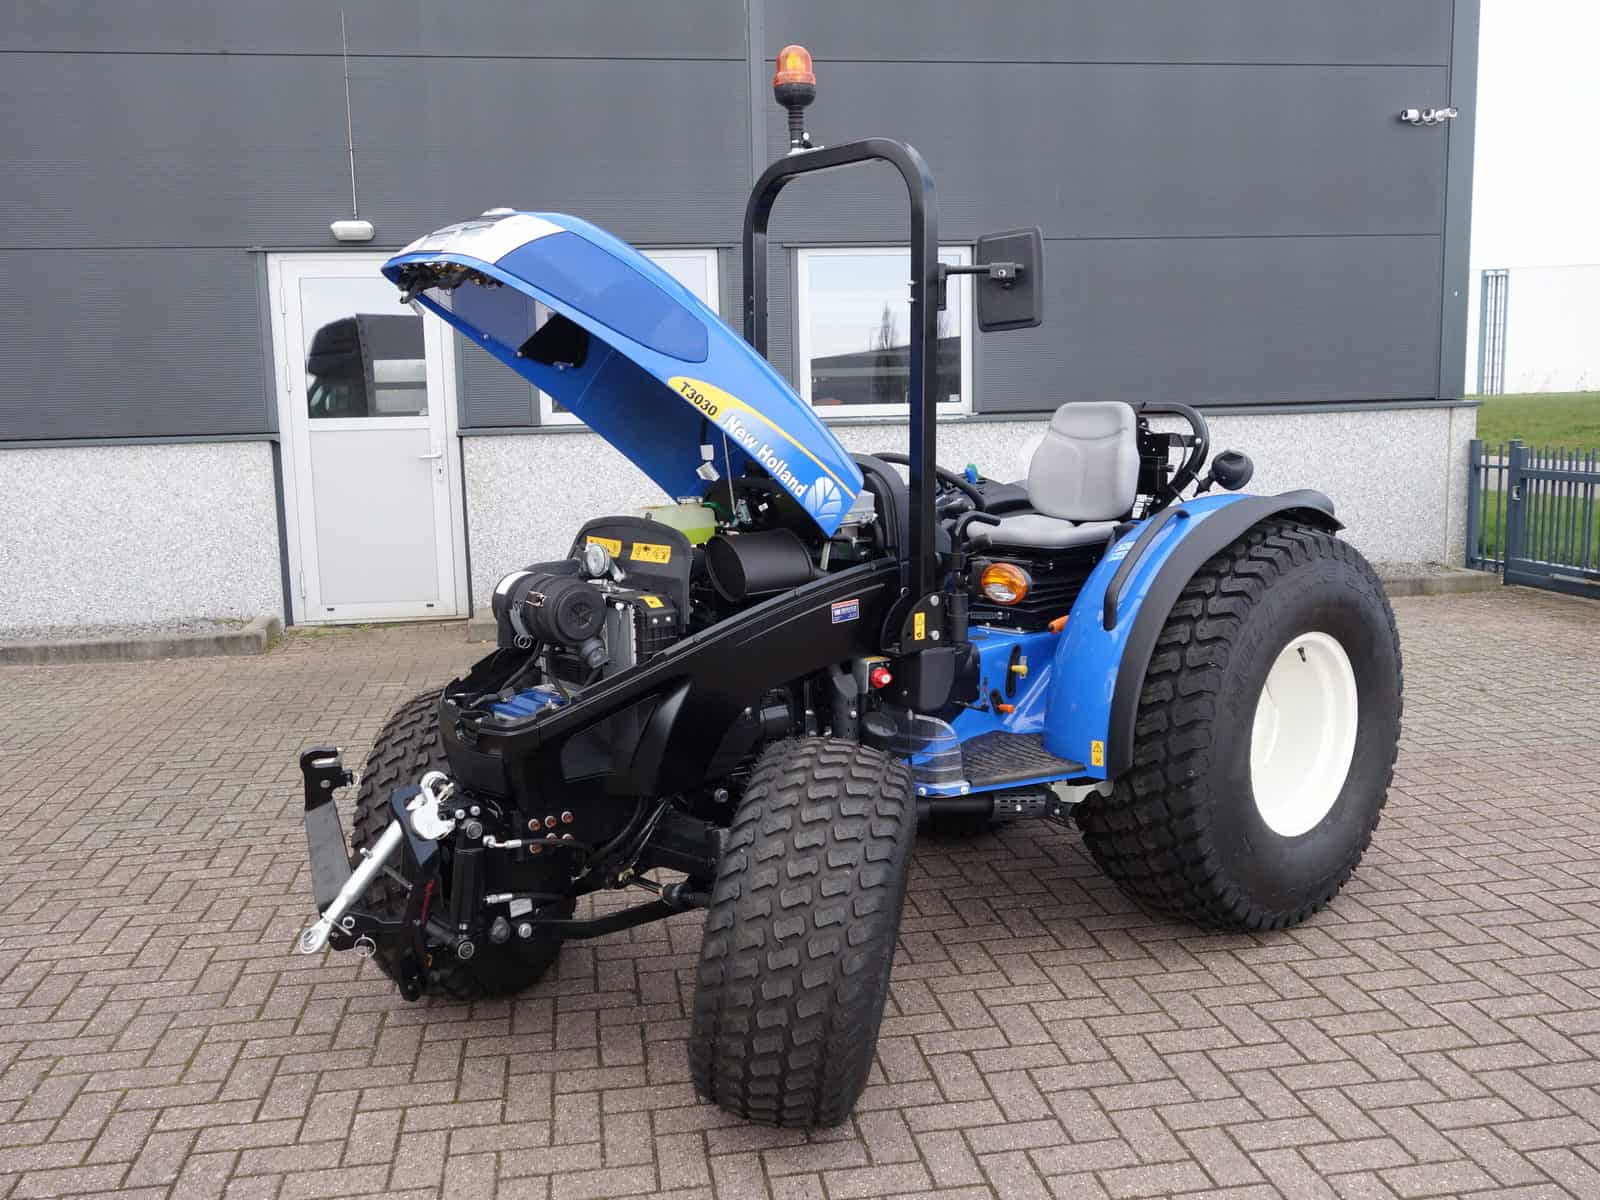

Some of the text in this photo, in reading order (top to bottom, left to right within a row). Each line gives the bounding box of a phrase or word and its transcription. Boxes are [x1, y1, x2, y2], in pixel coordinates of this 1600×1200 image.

[680, 381, 718, 416] T3030
[722, 415, 809, 497] New Holland
